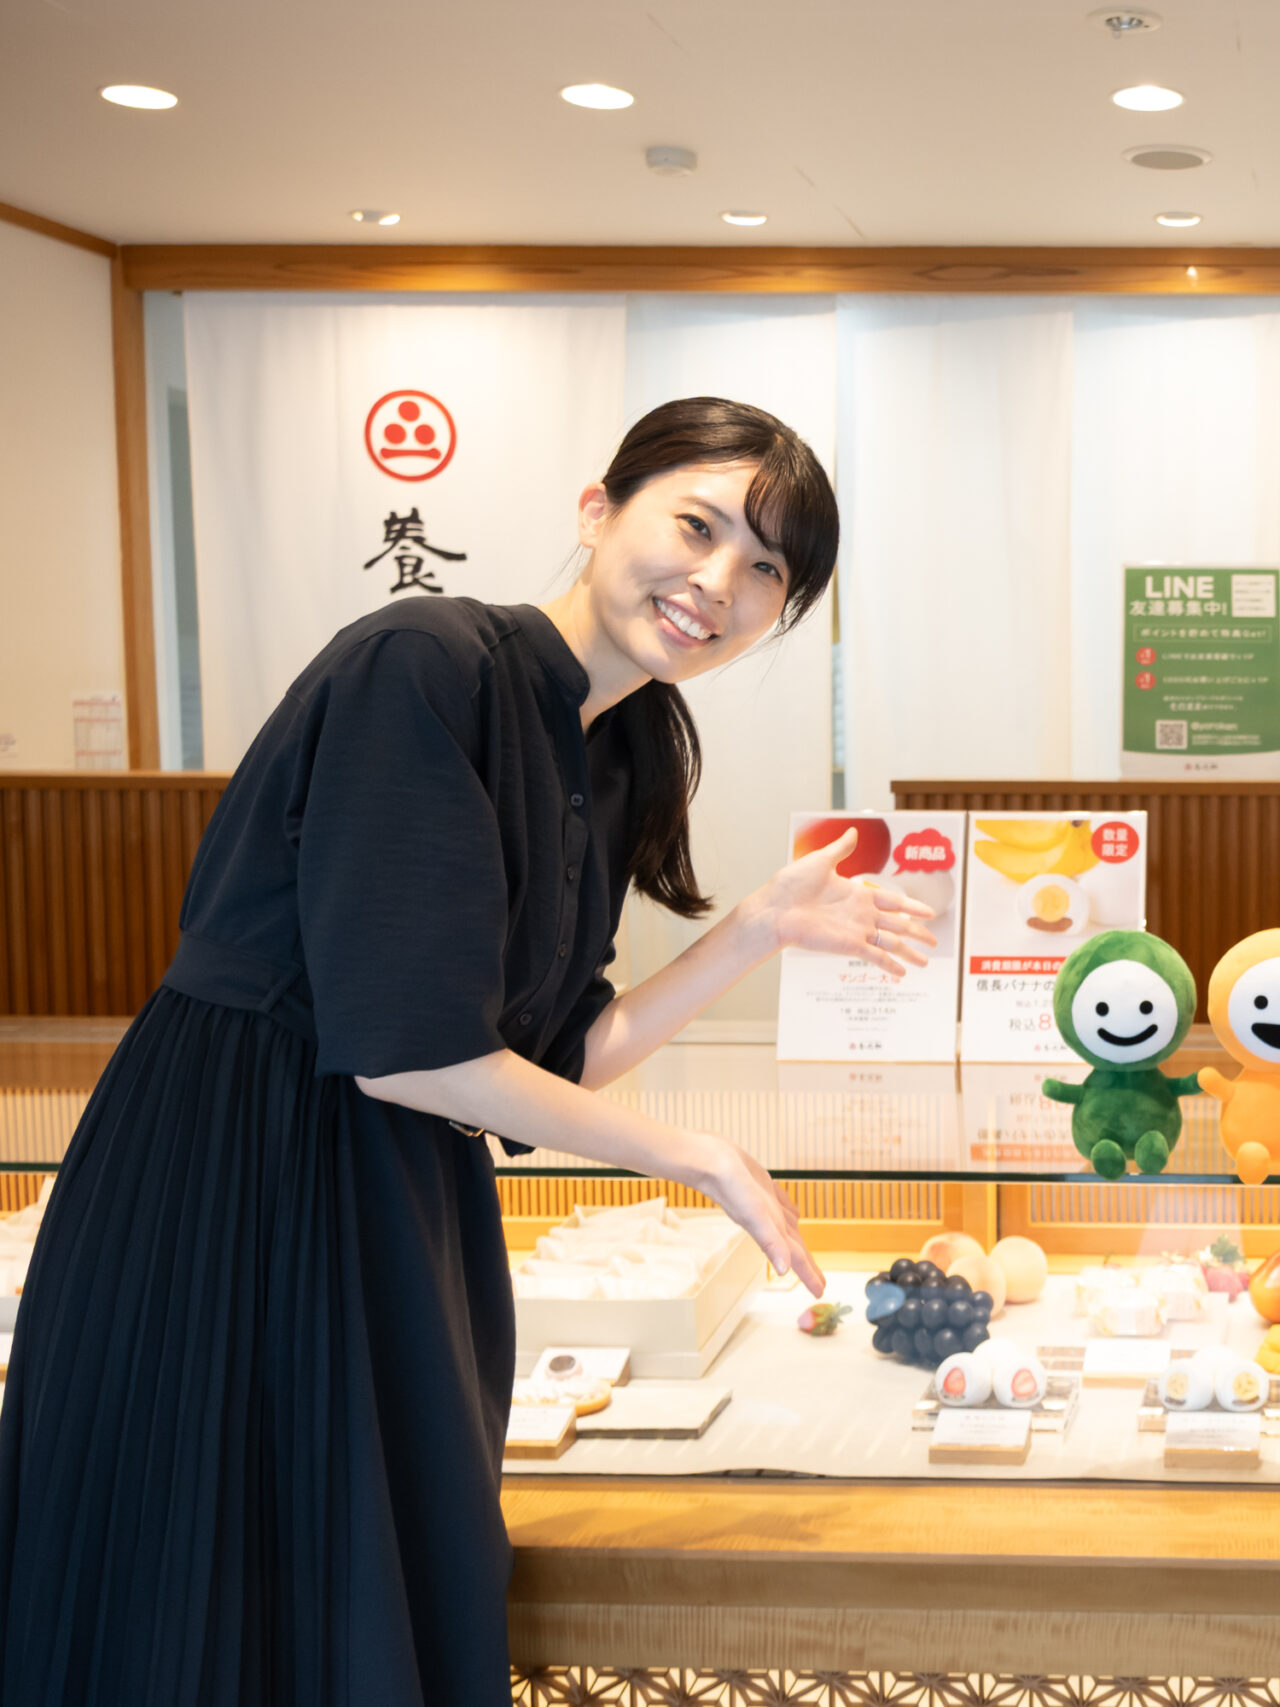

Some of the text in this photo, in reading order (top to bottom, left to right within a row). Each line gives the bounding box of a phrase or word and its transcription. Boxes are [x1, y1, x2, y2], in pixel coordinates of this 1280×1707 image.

[363, 507, 467, 594] 養
[1145, 576, 1214, 598] LINE
[1103, 828, 1128, 841] 数量
[905, 845, 946, 860] 新商品
[1102, 844, 1128, 857] 限定
[977, 979, 1055, 991] 信長バナナの
